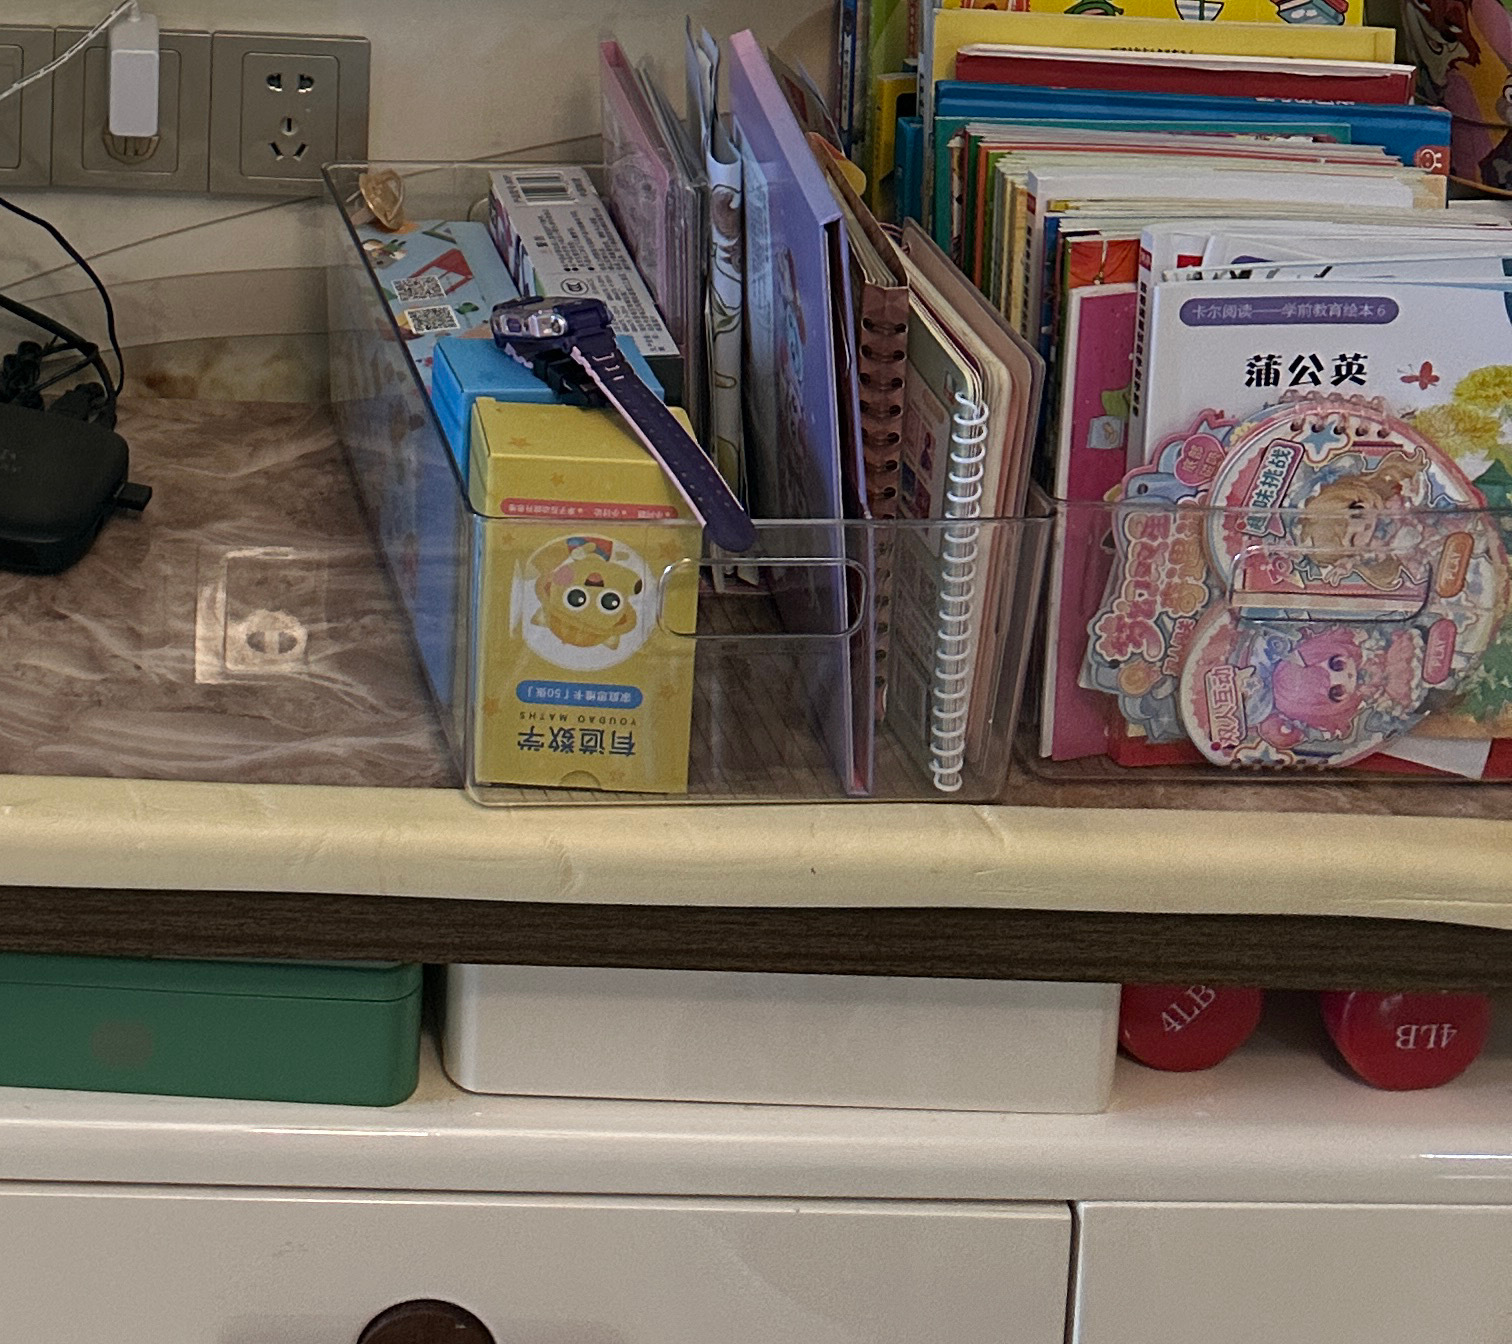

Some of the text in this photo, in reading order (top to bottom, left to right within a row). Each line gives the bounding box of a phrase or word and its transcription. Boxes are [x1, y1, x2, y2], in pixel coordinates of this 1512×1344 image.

[1244, 352, 1369, 388] 蒲公英
[519, 711, 637, 727] YOUDAO MATHS
[1210, 665, 1240, 748] 双人互动
[517, 725, 636, 757] 有道数学
[1159, 984, 1217, 1034] 4LB
[1395, 1023, 1458, 1050] 4LB
